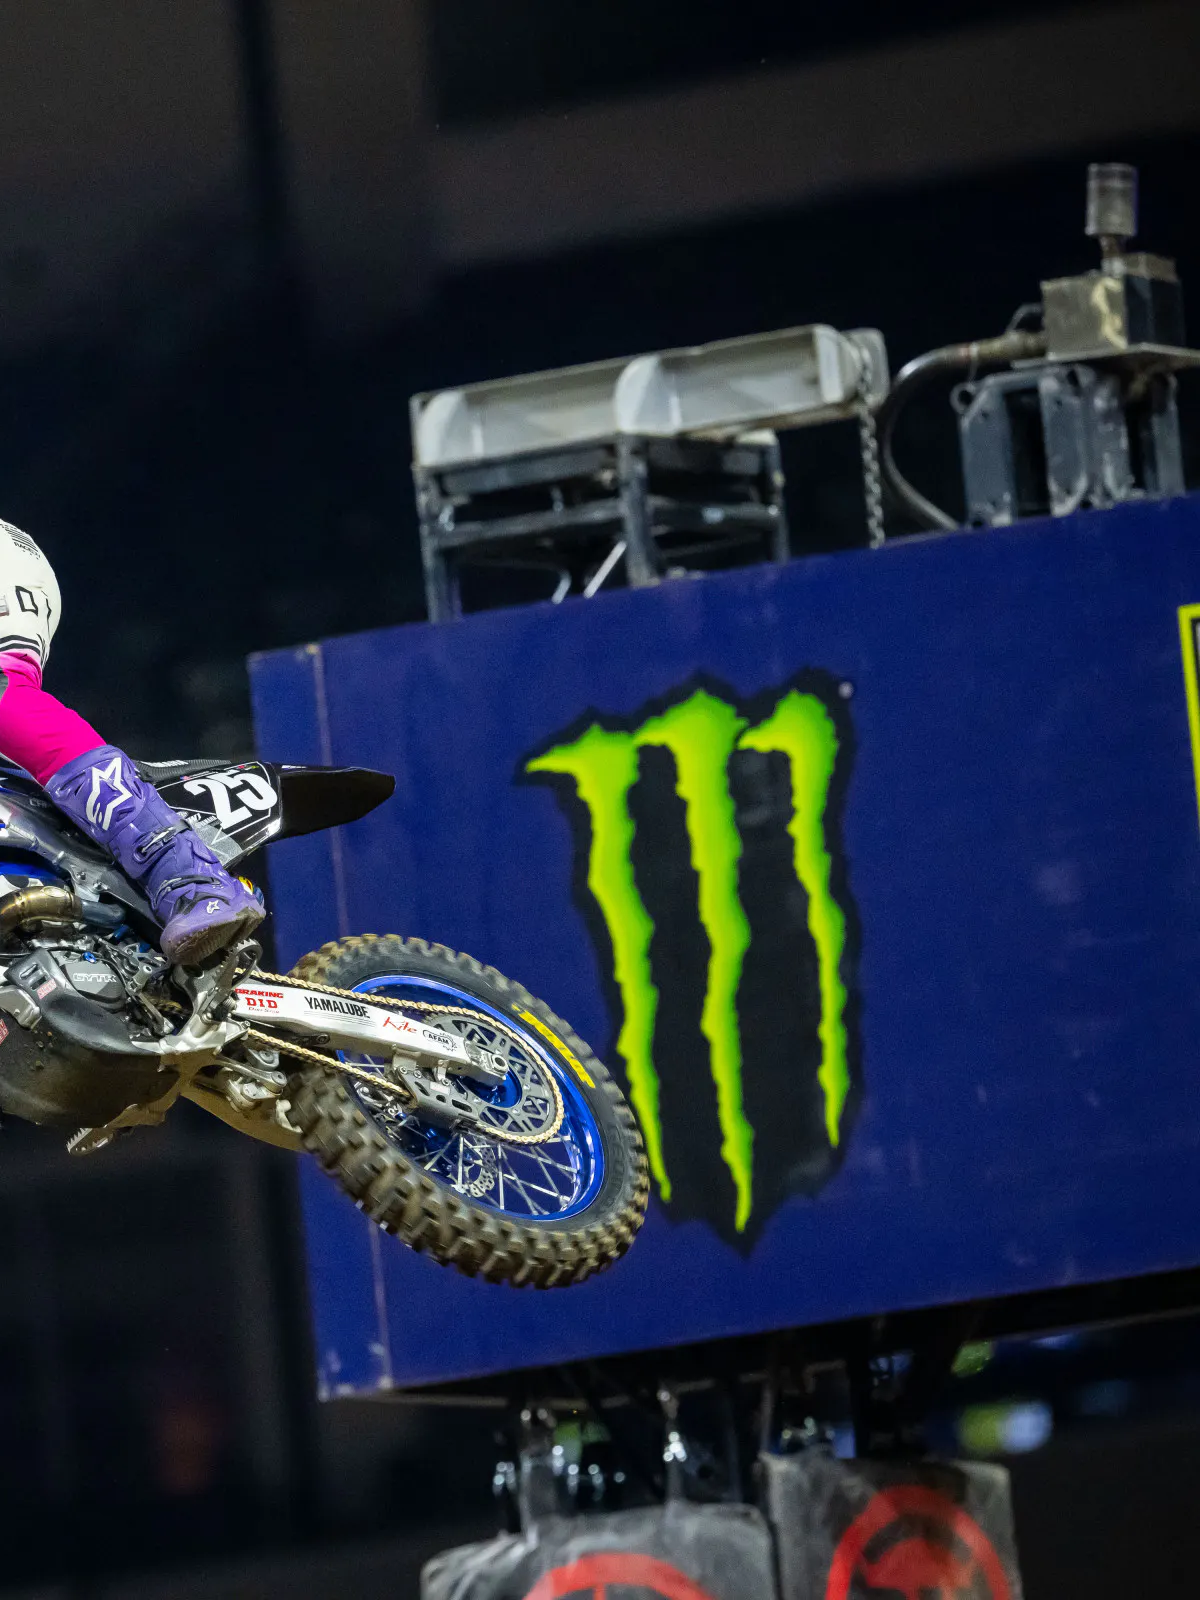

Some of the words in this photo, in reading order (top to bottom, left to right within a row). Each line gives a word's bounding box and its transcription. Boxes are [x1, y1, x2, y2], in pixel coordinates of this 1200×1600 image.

[183, 772, 278, 830] 25
[234, 988, 284, 998] BRAKING
[303, 996, 371, 1020] YAMALUBE
